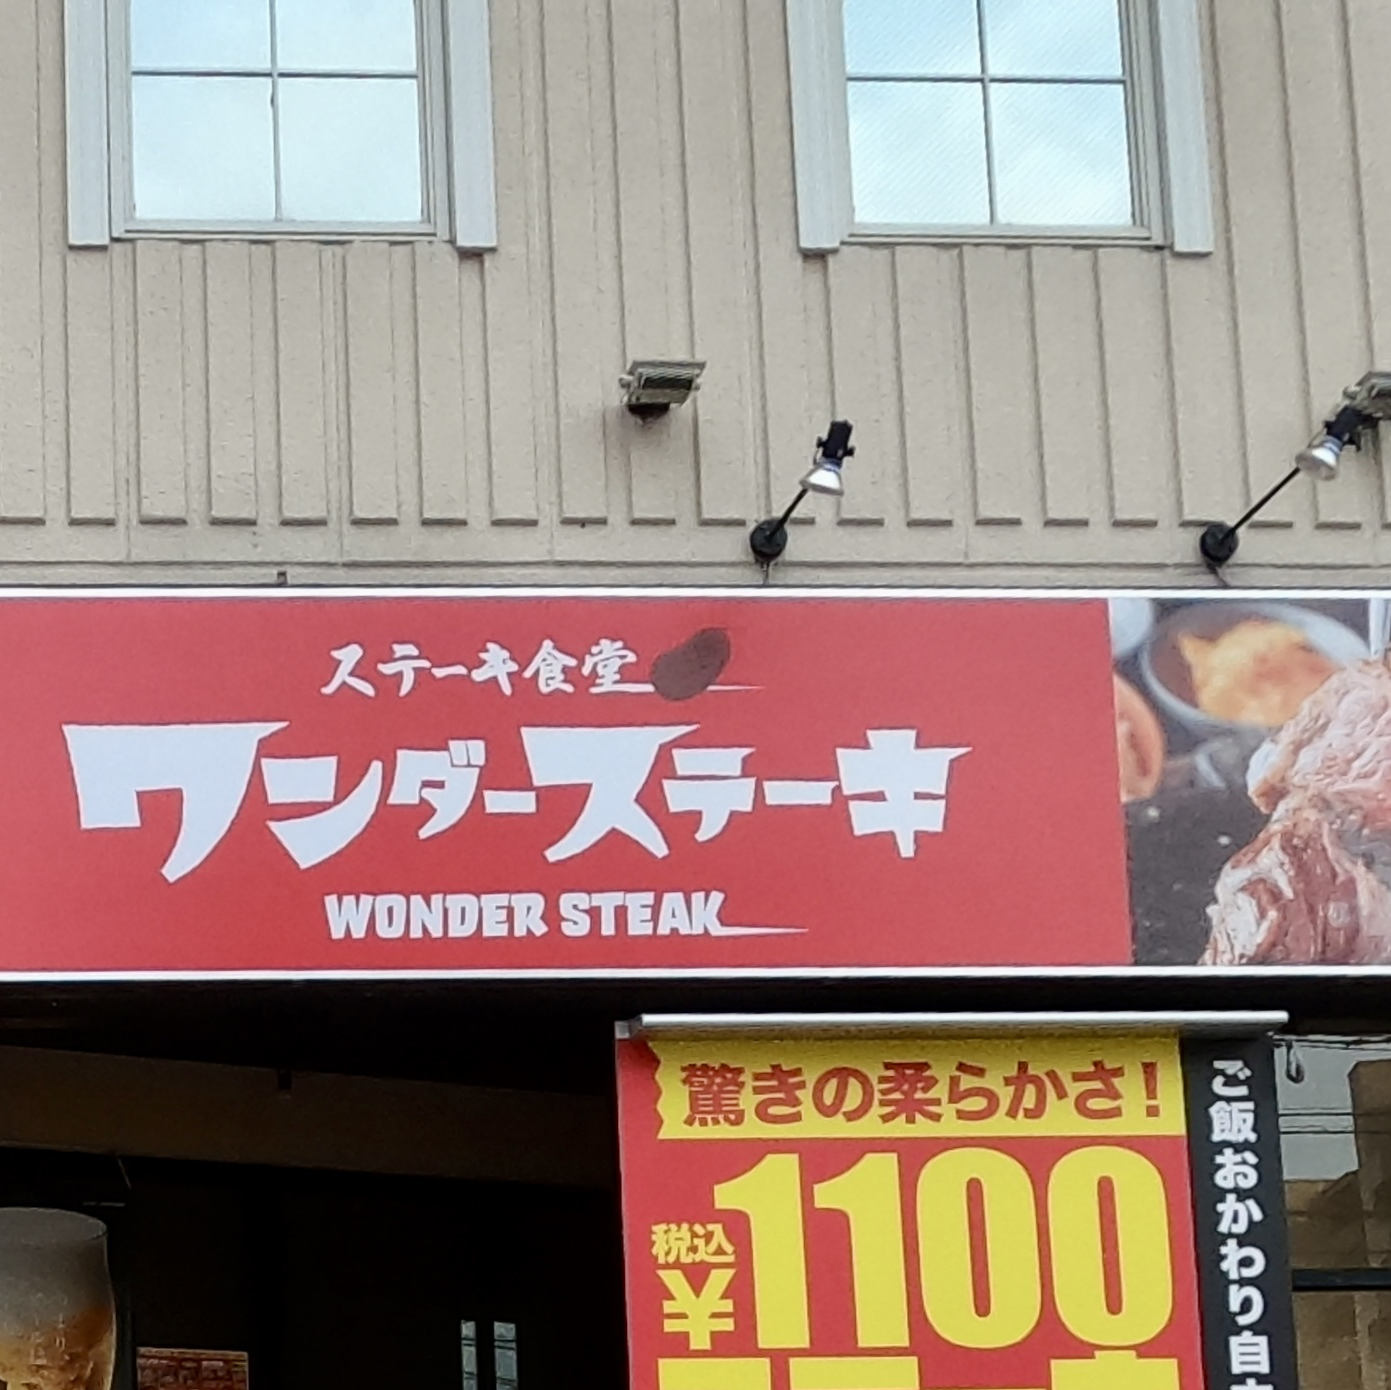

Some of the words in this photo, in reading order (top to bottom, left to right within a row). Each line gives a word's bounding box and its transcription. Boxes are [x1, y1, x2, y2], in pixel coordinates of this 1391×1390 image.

[320, 638, 641, 698] ステーキ食堂
[62, 721, 973, 883] ワンダーステーキ
[324, 893, 547, 940] WONDER
[560, 890, 728, 937] STEAK
[651, 1222, 736, 1264] 税込
